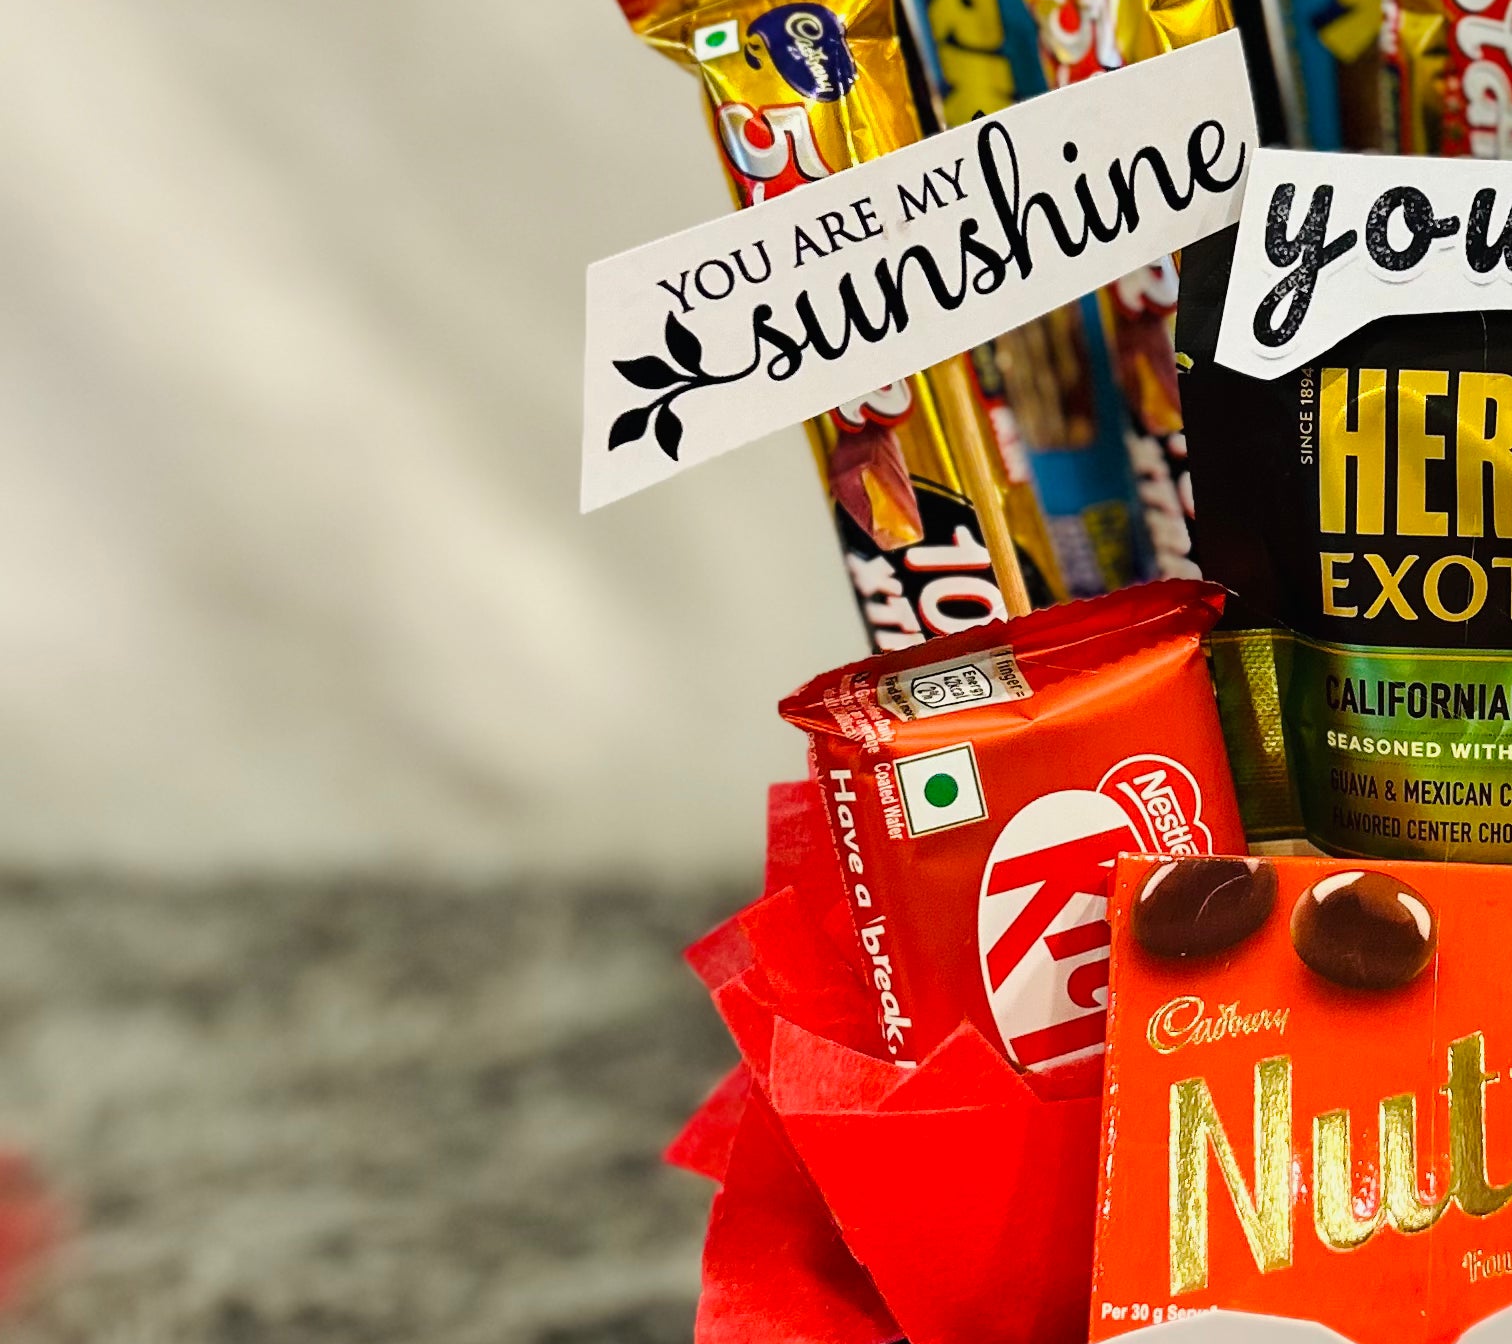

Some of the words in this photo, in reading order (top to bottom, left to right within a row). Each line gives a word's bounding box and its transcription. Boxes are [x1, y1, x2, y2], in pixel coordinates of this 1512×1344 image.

[657, 239, 773, 315] YOU
[793, 197, 890, 269] ARE
[896, 157, 969, 226] MY
[748, 112, 1246, 383] sunshine
[1301, 367, 1315, 406] 1894
[1301, 409, 1315, 465] SINCE
[1326, 730, 1442, 759] SEASONED
[873, 761, 895, 805] Coated
[1330, 768, 1380, 802] GUAVA
[1384, 778, 1398, 803] &
[1403, 778, 1493, 808] MEXICAN
[829, 768, 863, 875] Have
[853, 883, 872, 908] a
[883, 805, 904, 840] Wafer
[1332, 806, 1400, 839] FLAVORED
[1406, 818, 1473, 844] CENTER
[1146, 996, 1290, 1055] Cadbury
[1101, 1302, 1128, 1321] Per
[1131, 1303, 1150, 1321] 30
[1152, 1309, 1164, 1324] g
